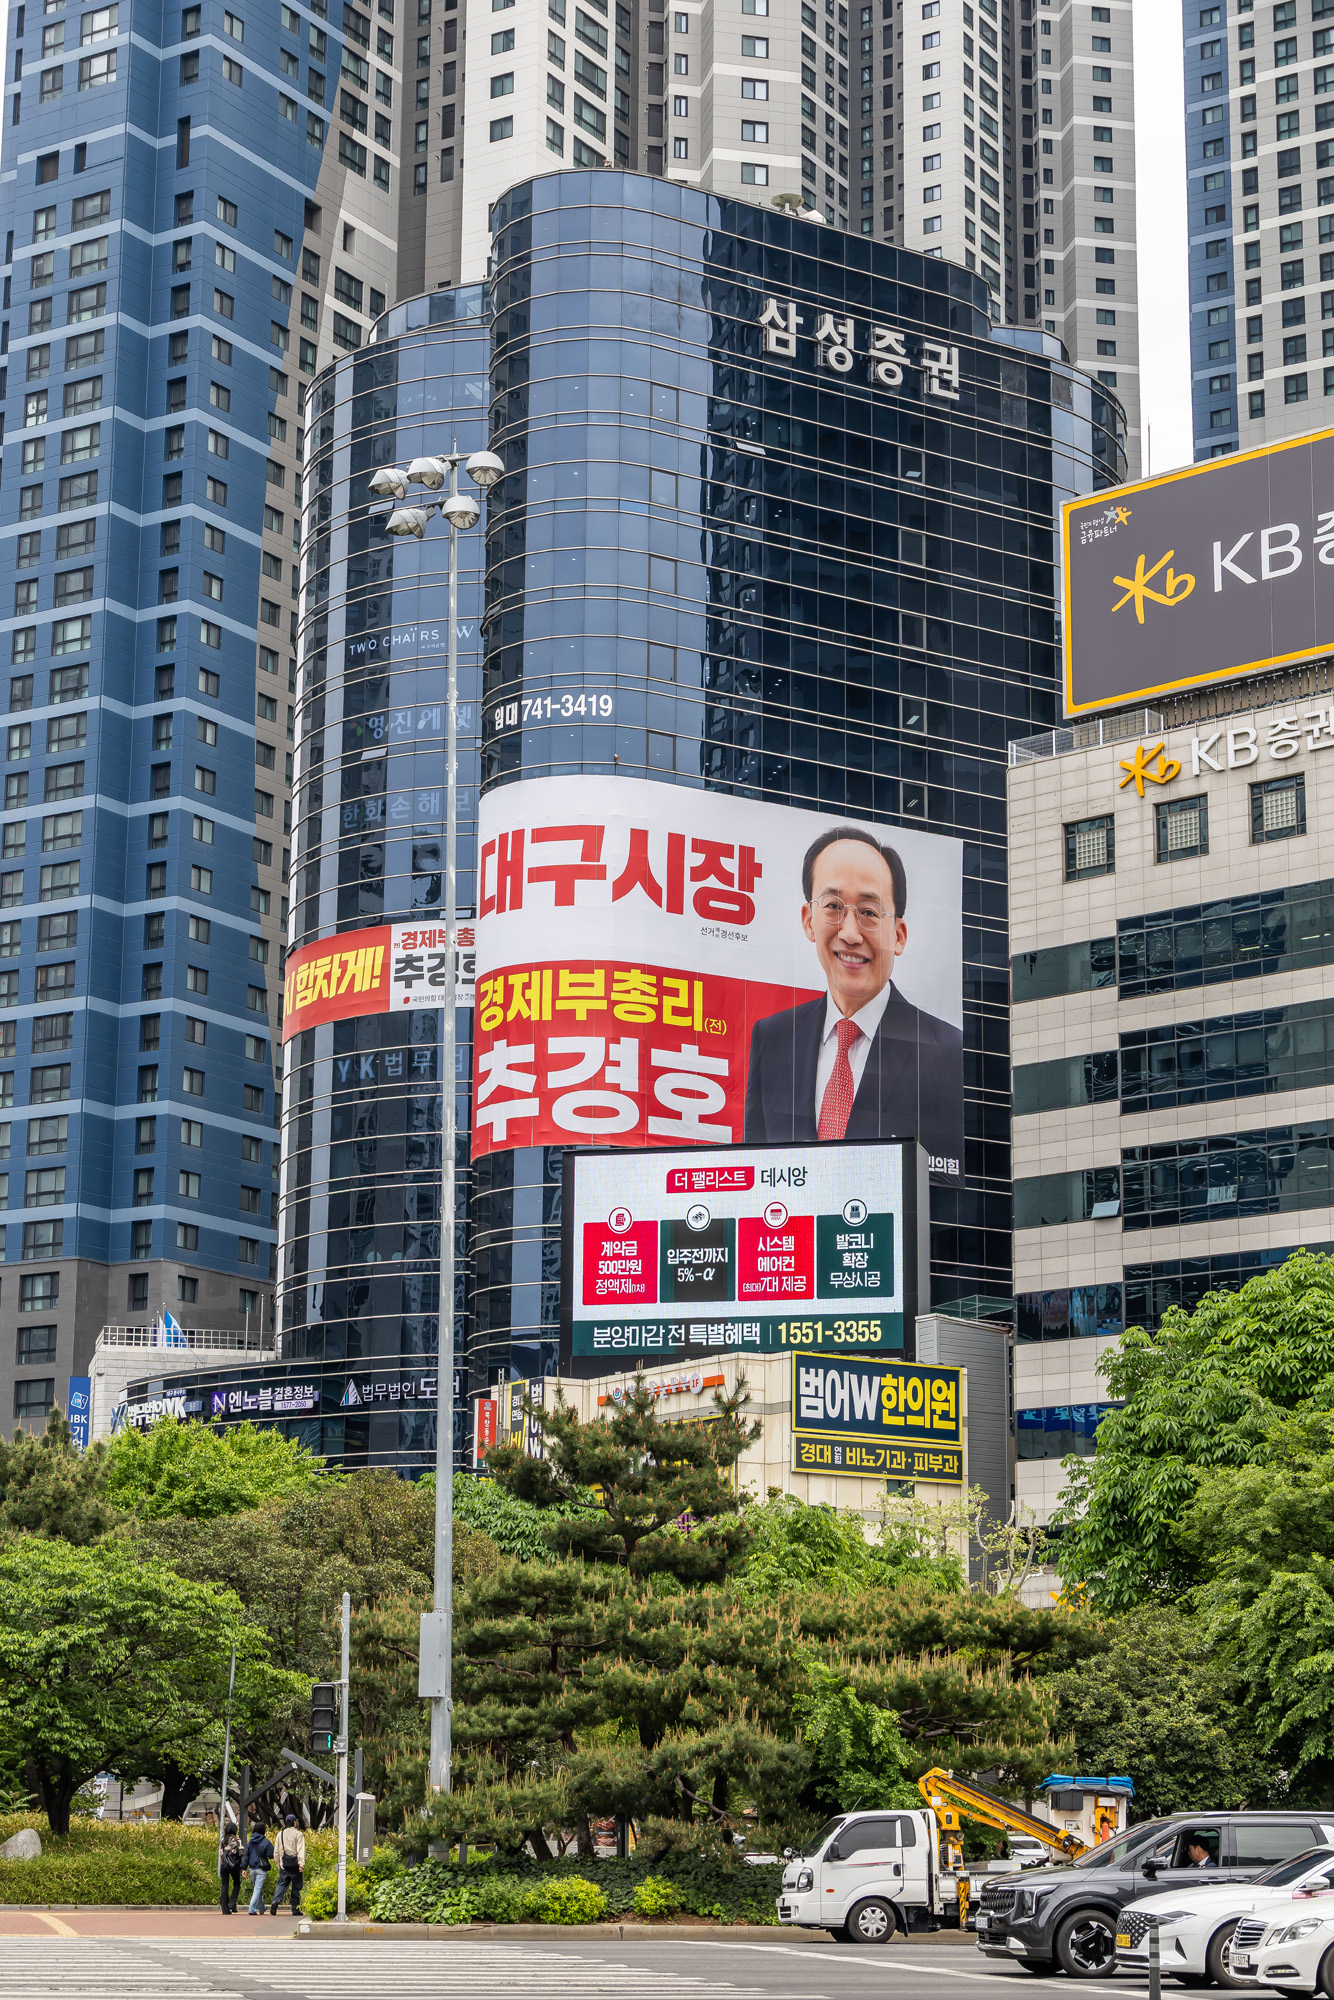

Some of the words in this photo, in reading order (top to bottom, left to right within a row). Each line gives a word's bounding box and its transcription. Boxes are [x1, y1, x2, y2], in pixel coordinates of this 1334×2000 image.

[758, 298, 960, 401] 삼성증권
[1080, 525, 1117, 545] 금융파트너
[349, 640, 377, 655] TWO
[494, 701, 518, 730] 임대
[521, 694, 613, 722] 741-3419
[368, 705, 471, 740] 영진에셋
[480, 824, 762, 925] 대구시장
[295, 946, 385, 1010] 힘차게!
[412, 994, 437, 1003] 국민의힘
[477, 1037, 732, 1143] 추경호
[675, 1172, 688, 1189] 더
[691, 1169, 747, 1189] 팰리스트
[760, 1167, 808, 1187] 데시앙
[601, 1240, 638, 1256] 계약금
[757, 1235, 795, 1251] 시스템
[836, 1232, 874, 1250] 발코니
[667, 1247, 729, 1264] 입주전까지
[757, 1256, 795, 1272] 에어컨
[842, 1252, 869, 1269] 확장
[598, 1259, 642, 1275] 500만원
[781, 1275, 807, 1292] 제공
[830, 1271, 881, 1288] 무상시공
[593, 1325, 664, 1348] 분양마감
[668, 1325, 685, 1346] 전
[689, 1322, 760, 1345] 특별혜택
[778, 1319, 882, 1344] 1551-3355
[362, 1381, 416, 1402] 법무법인
[692, 1378, 700, 1388] 1F
[213, 1392, 227, 1413] N
[228, 1387, 273, 1413] 엔노블
[273, 1385, 314, 1401] 결혼정보
[281, 1400, 307, 1409] 1577-2050
[799, 1366, 956, 1430] 범어W한의원
[70, 1414, 88, 1424] IBK
[800, 1442, 832, 1464] 경대
[834, 1446, 842, 1465] 연합
